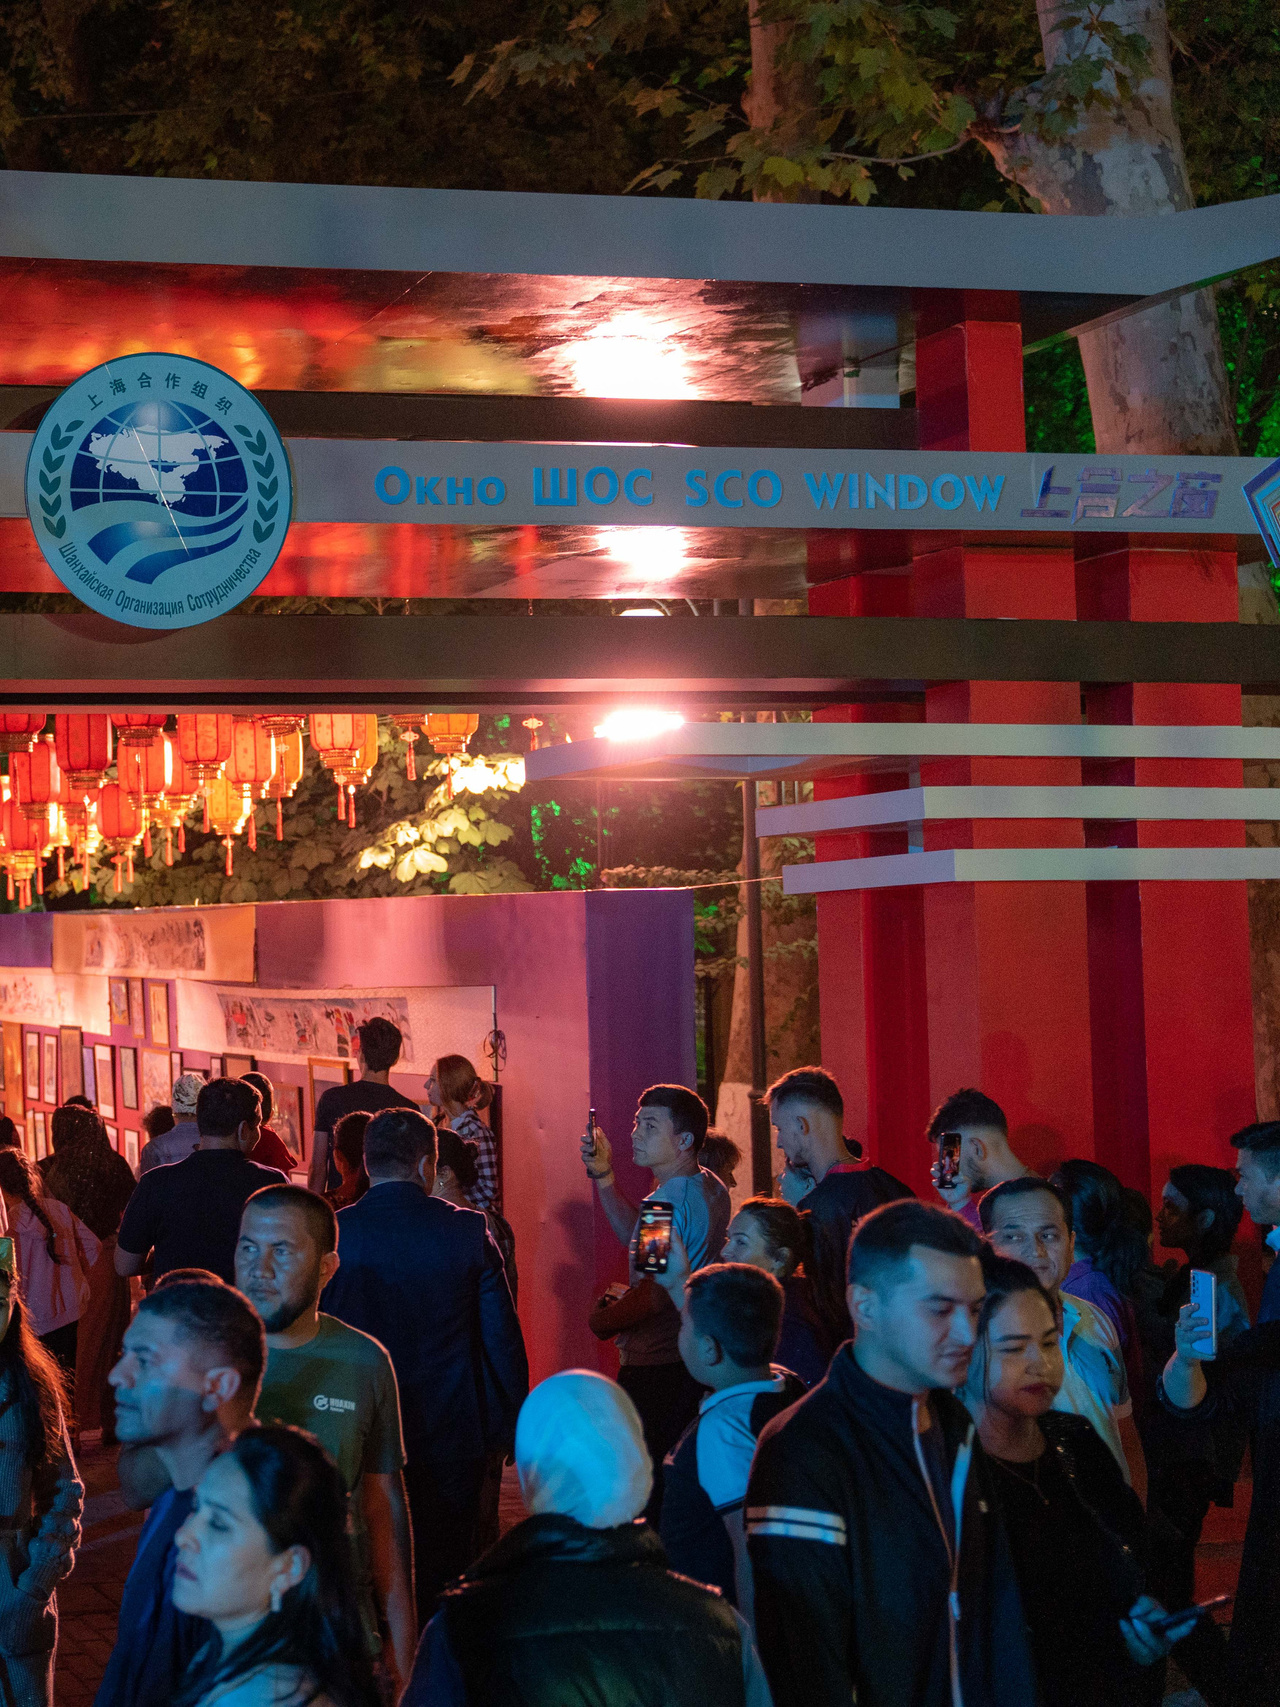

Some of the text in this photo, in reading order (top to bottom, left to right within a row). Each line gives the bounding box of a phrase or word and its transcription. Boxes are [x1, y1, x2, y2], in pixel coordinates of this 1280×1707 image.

[87, 372, 233, 415] 上海合作组织
[374, 465, 654, 507] Окно ШОС
[685, 469, 1006, 512] SCO WINDOW
[58, 541, 262, 618] Шанхайская Организация Сотрудничества
